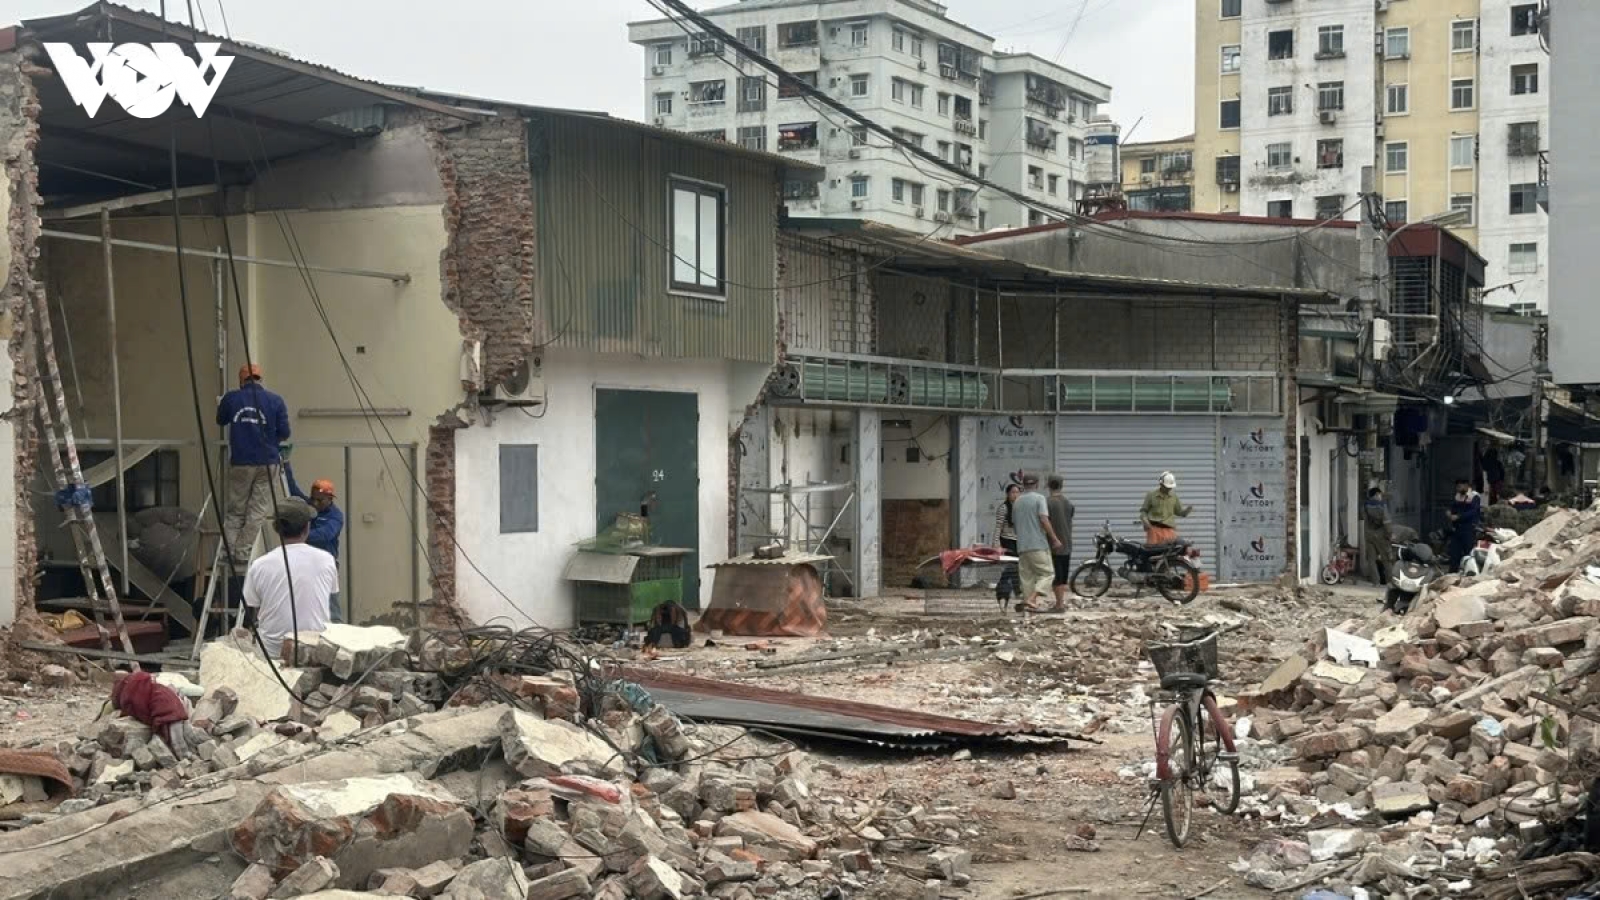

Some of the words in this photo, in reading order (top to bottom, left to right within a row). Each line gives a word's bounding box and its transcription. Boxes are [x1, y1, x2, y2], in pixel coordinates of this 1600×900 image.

[998, 424, 1035, 437] VICTORY
[1239, 440, 1275, 452] VICTORY
[1239, 494, 1275, 507] VICTORY
[1239, 548, 1275, 561] VICTORY
